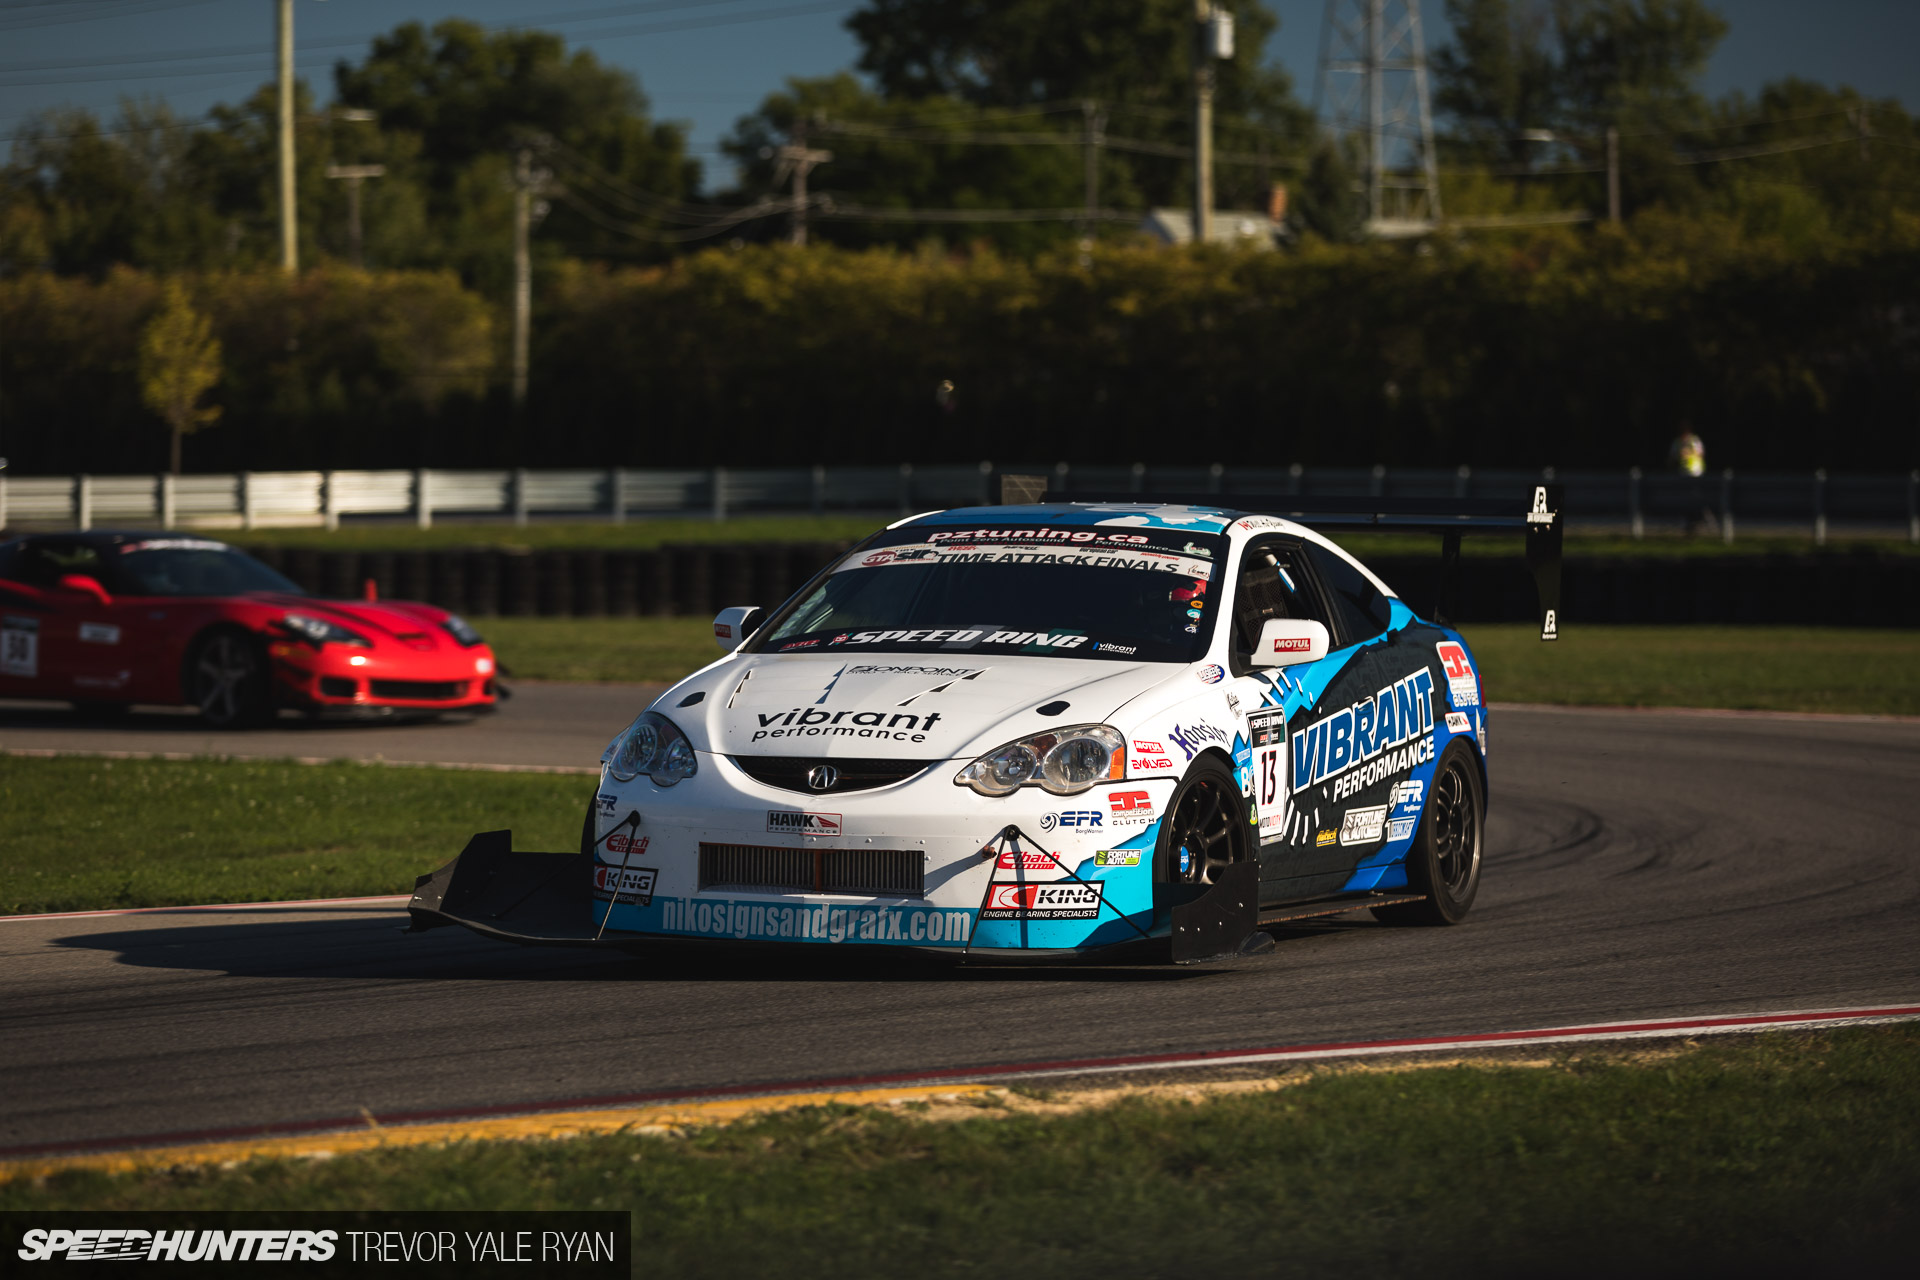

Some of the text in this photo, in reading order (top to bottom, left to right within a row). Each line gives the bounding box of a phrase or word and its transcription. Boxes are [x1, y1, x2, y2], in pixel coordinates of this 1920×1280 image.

[926, 528, 1149, 545] pztuning.ca
[1002, 536, 1065, 544] Autosound
[1095, 540, 1169, 551] Performance
[937, 552, 996, 564] TIME
[990, 552, 1094, 567] ATTACK
[1092, 557, 1180, 574] FINALS
[846, 629, 1089, 649] SPEED RING
[1275, 639, 1310, 649] MOTUL
[1100, 642, 1137, 653] vibrant
[758, 707, 942, 732] vibrant
[1253, 717, 1271, 729] SPEED
[751, 725, 926, 743] performance
[1292, 665, 1435, 795] VIBRANT
[1135, 741, 1162, 751] MOTUL
[1131, 757, 1173, 770] EVOLVED
[1333, 735, 1435, 803] PERFORMANCE
[1261, 750, 1277, 806] 13
[1397, 779, 1424, 803] EFR
[769, 812, 815, 828] HAWK
[1059, 811, 1104, 827] EFR
[1112, 807, 1154, 819] competition
[1352, 809, 1386, 828] FORTUNE
[1112, 817, 1155, 826] CLUTCH
[769, 826, 838, 834] PERFORMANCE
[1106, 857, 1126, 865] AUTO
[1107, 850, 1140, 859] FORTUNE
[1038, 889, 1099, 904] KING
[662, 897, 971, 944] nikosignsandgrafx.com
[983, 909, 1098, 918] ENGINE BEARING SPECIALISTS
